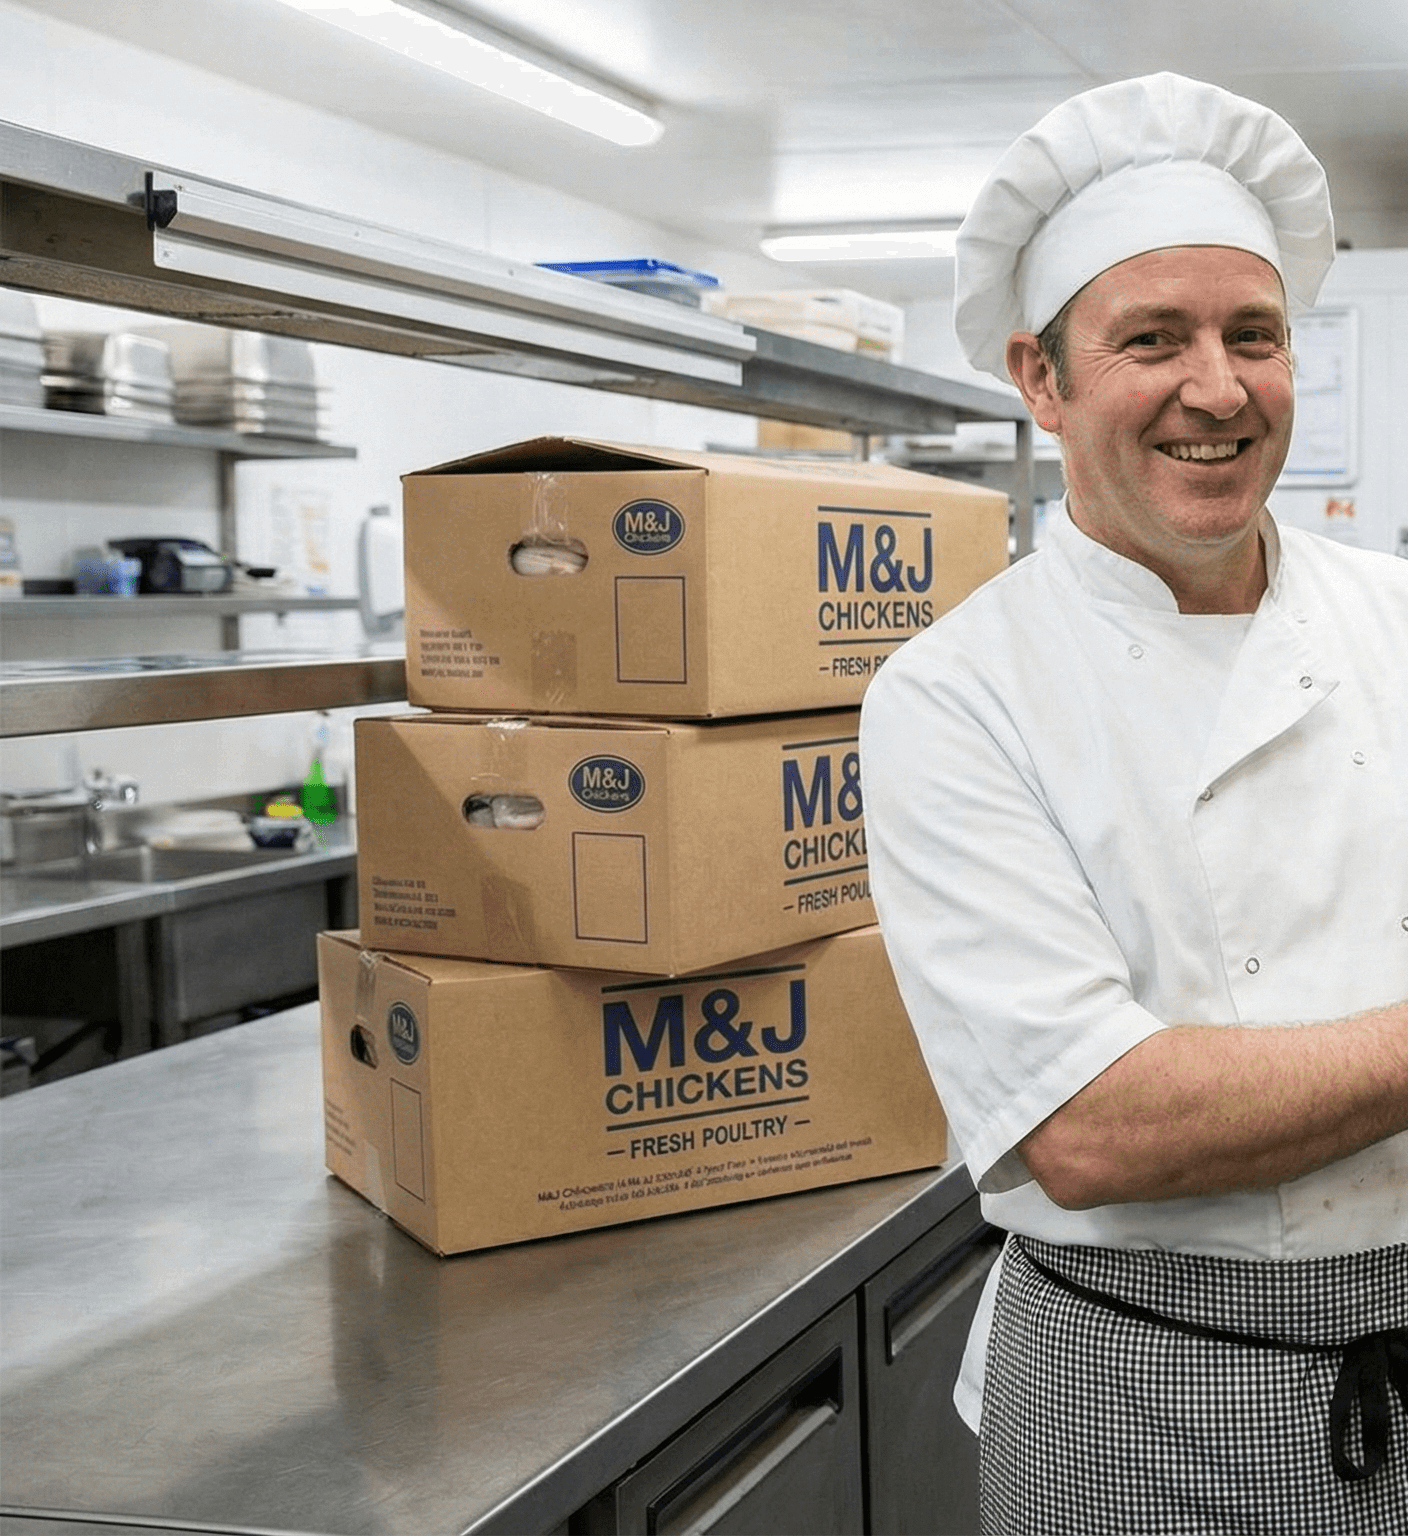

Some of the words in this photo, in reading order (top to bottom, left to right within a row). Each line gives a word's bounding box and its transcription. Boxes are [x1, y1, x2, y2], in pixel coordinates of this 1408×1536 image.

[624, 511, 670, 532] M&J
[818, 522, 933, 593] M&J
[818, 600, 934, 631] CHICKENS
[832, 656, 871, 678] FRESH
[582, 766, 630, 790] M&J
[798, 885, 838, 915] FRESH
[603, 979, 807, 1077] M&J
[605, 1058, 809, 1115] CHICKENS
[630, 1130, 695, 1159] FRESH
[702, 1115, 788, 1147] POULTRY
